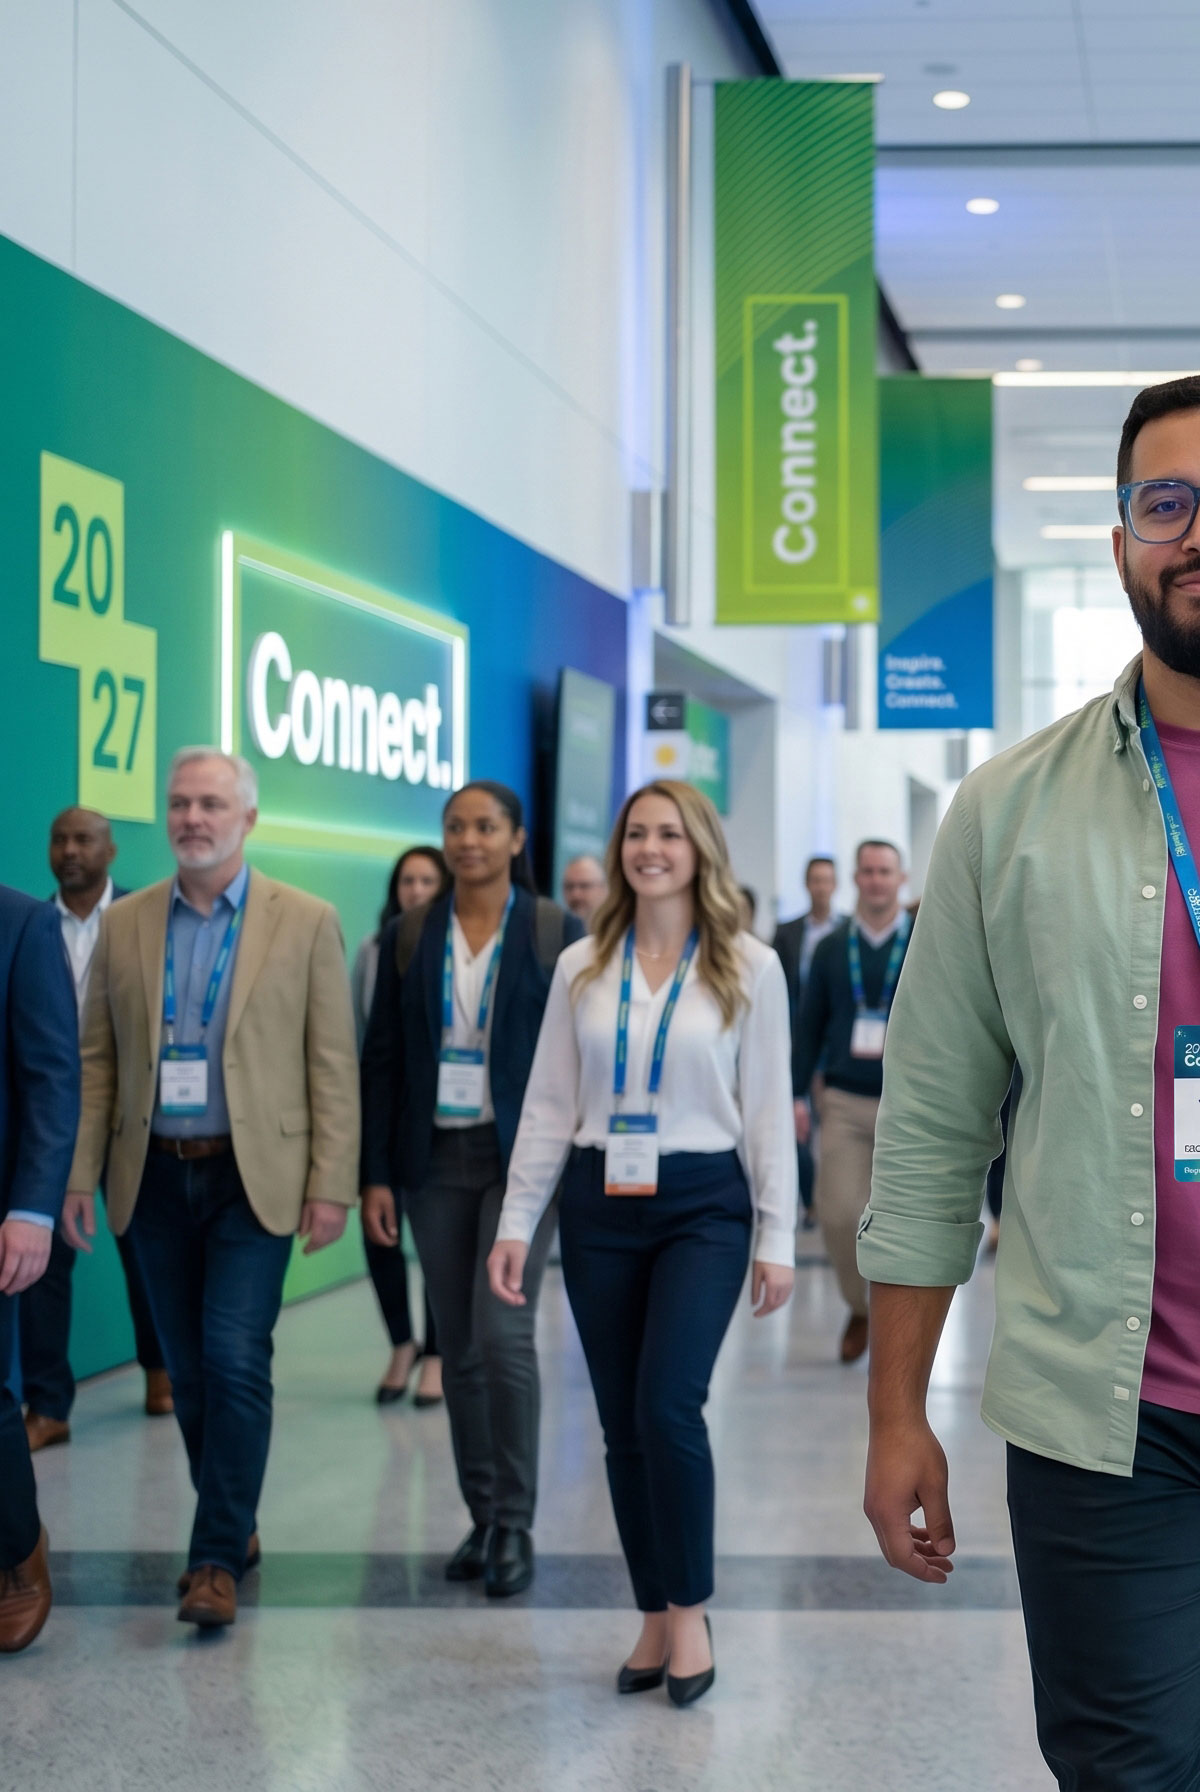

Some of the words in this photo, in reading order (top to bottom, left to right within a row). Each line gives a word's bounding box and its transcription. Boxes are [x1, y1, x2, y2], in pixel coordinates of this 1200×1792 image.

[772, 319, 818, 564] Connect.
[52, 503, 114, 615] 20
[249, 630, 451, 790] Connect.
[885, 654, 947, 674] Inspire.
[885, 691, 959, 709] Connect.
[92, 669, 146, 770] 27
